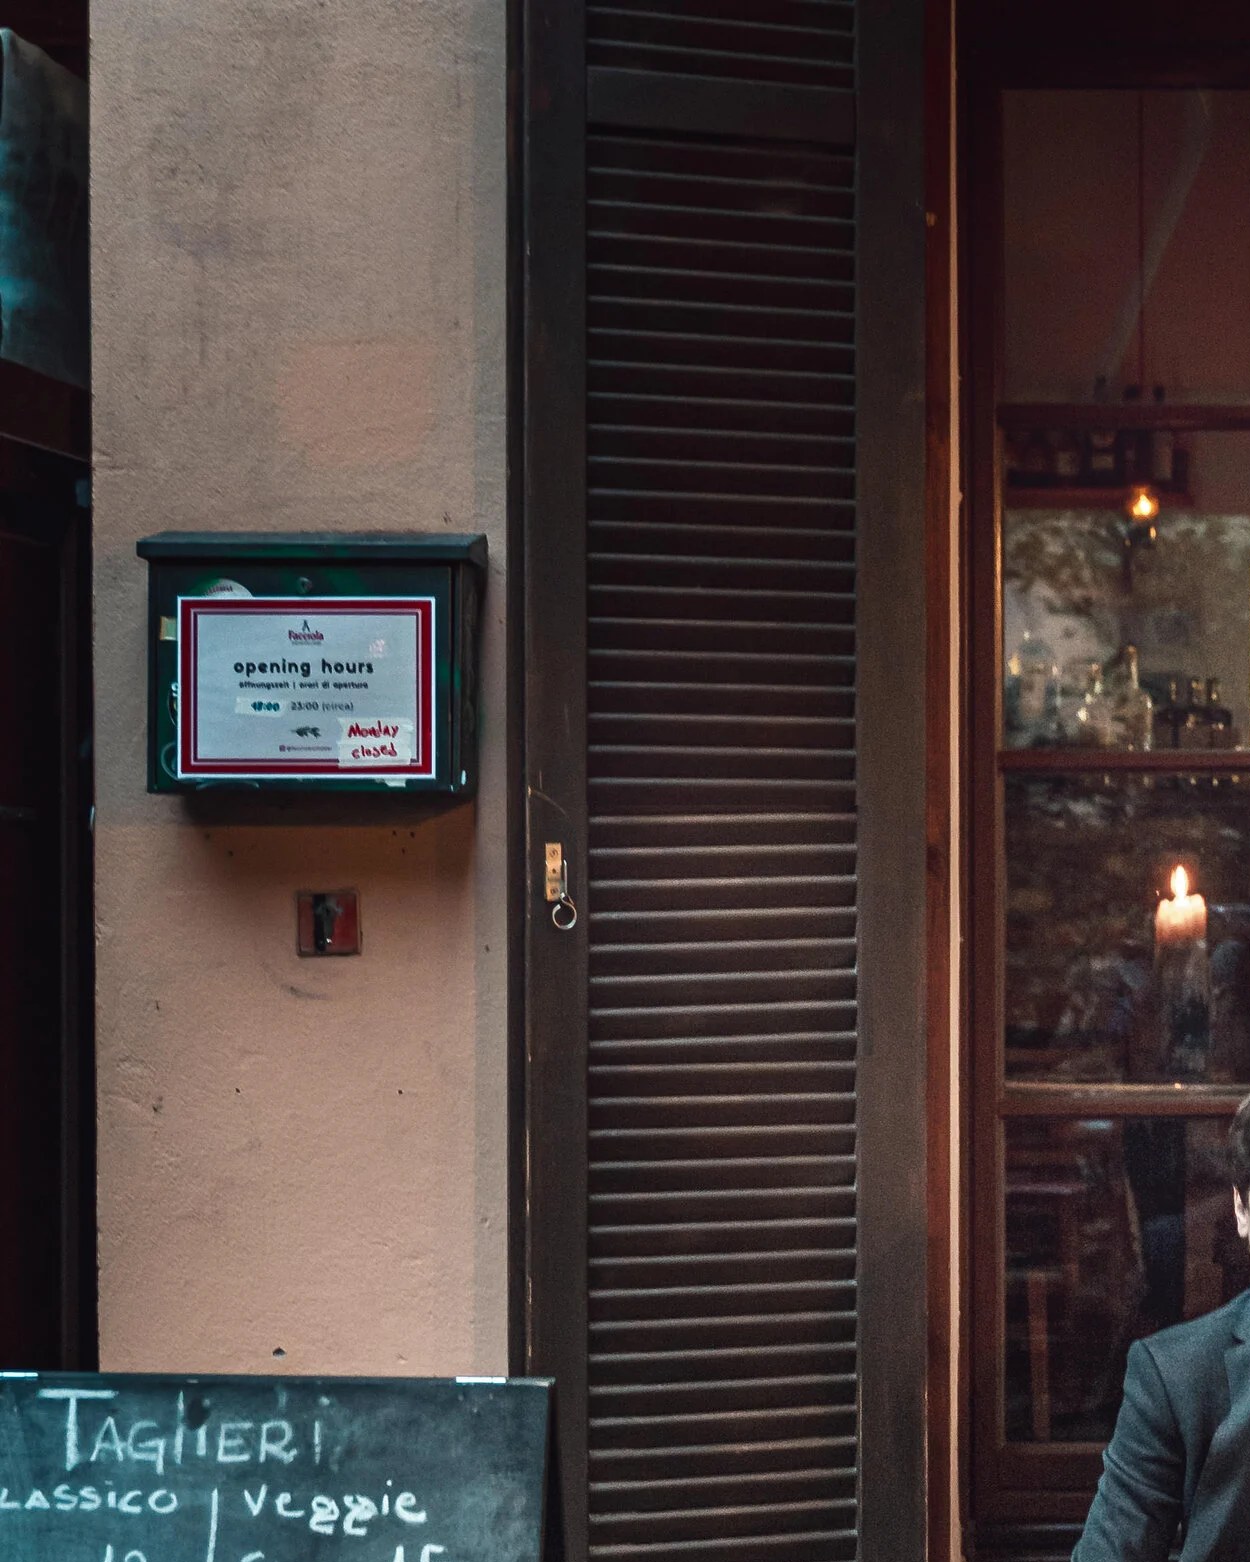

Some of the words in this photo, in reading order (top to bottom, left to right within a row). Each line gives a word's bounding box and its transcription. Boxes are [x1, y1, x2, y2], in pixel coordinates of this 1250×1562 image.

[233, 658, 310, 677] opening
[322, 658, 374, 674] hours
[347, 720, 399, 739] Monday
[351, 743, 398, 759] closed
